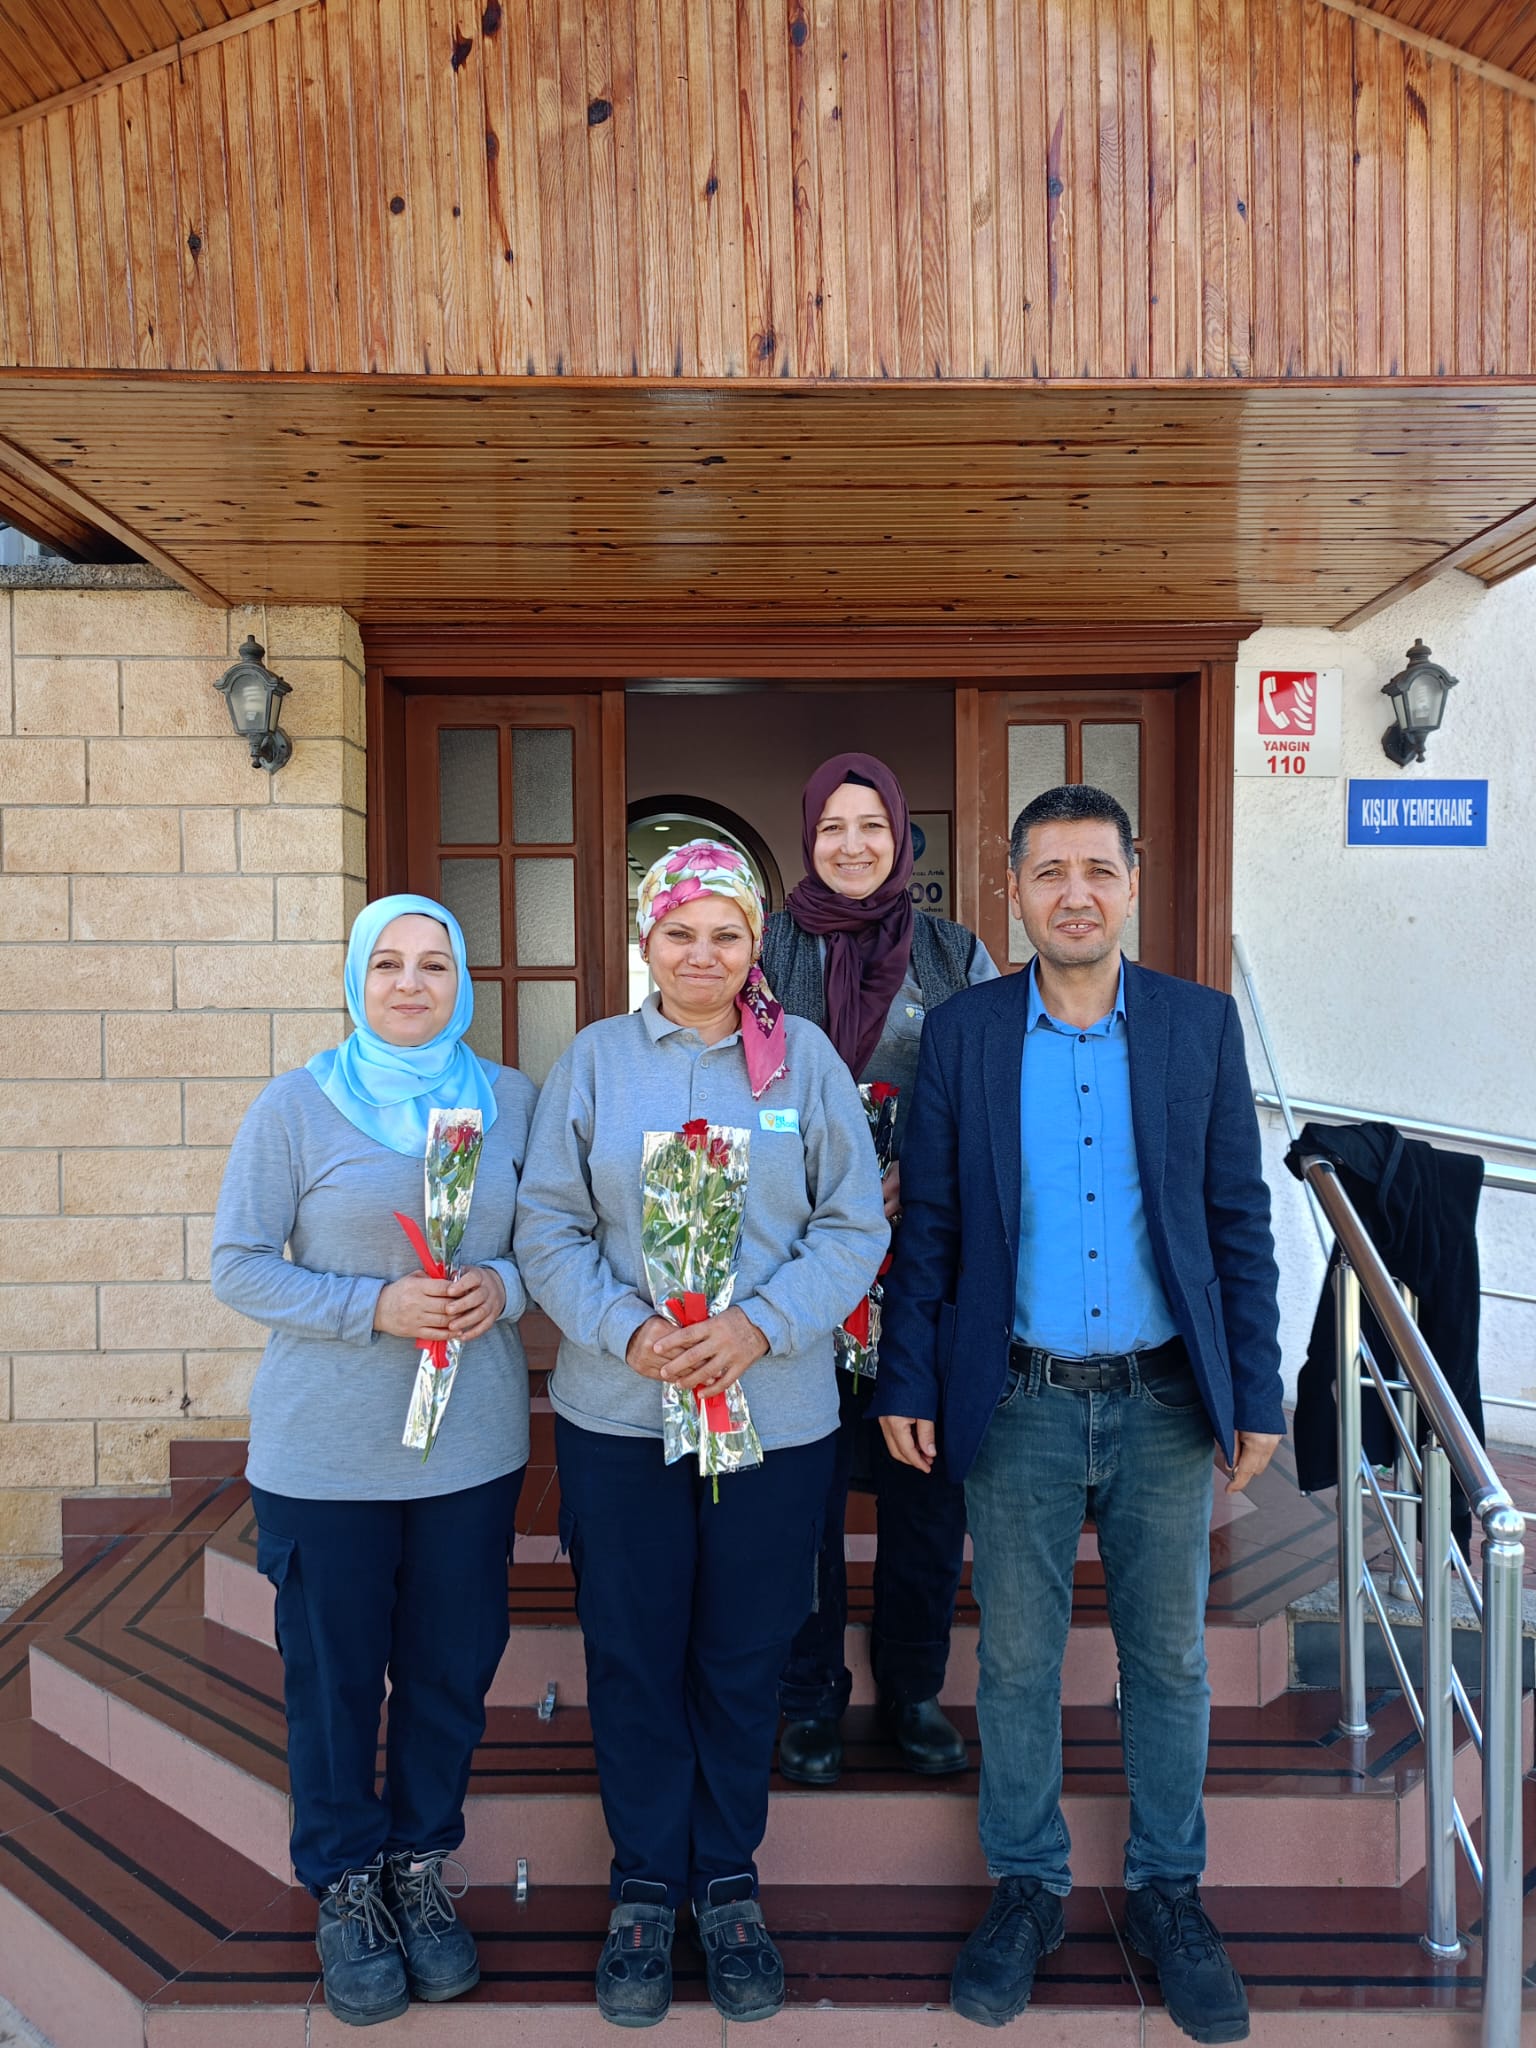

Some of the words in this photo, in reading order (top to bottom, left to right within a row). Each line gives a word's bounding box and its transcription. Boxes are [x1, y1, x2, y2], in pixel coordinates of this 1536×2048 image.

[1264, 741, 1310, 752] YANGIN
[1267, 755, 1306, 774] 110
[1362, 798, 1399, 834] KIŞLIK
[1403, 798, 1473, 827] YEMEKHANE
